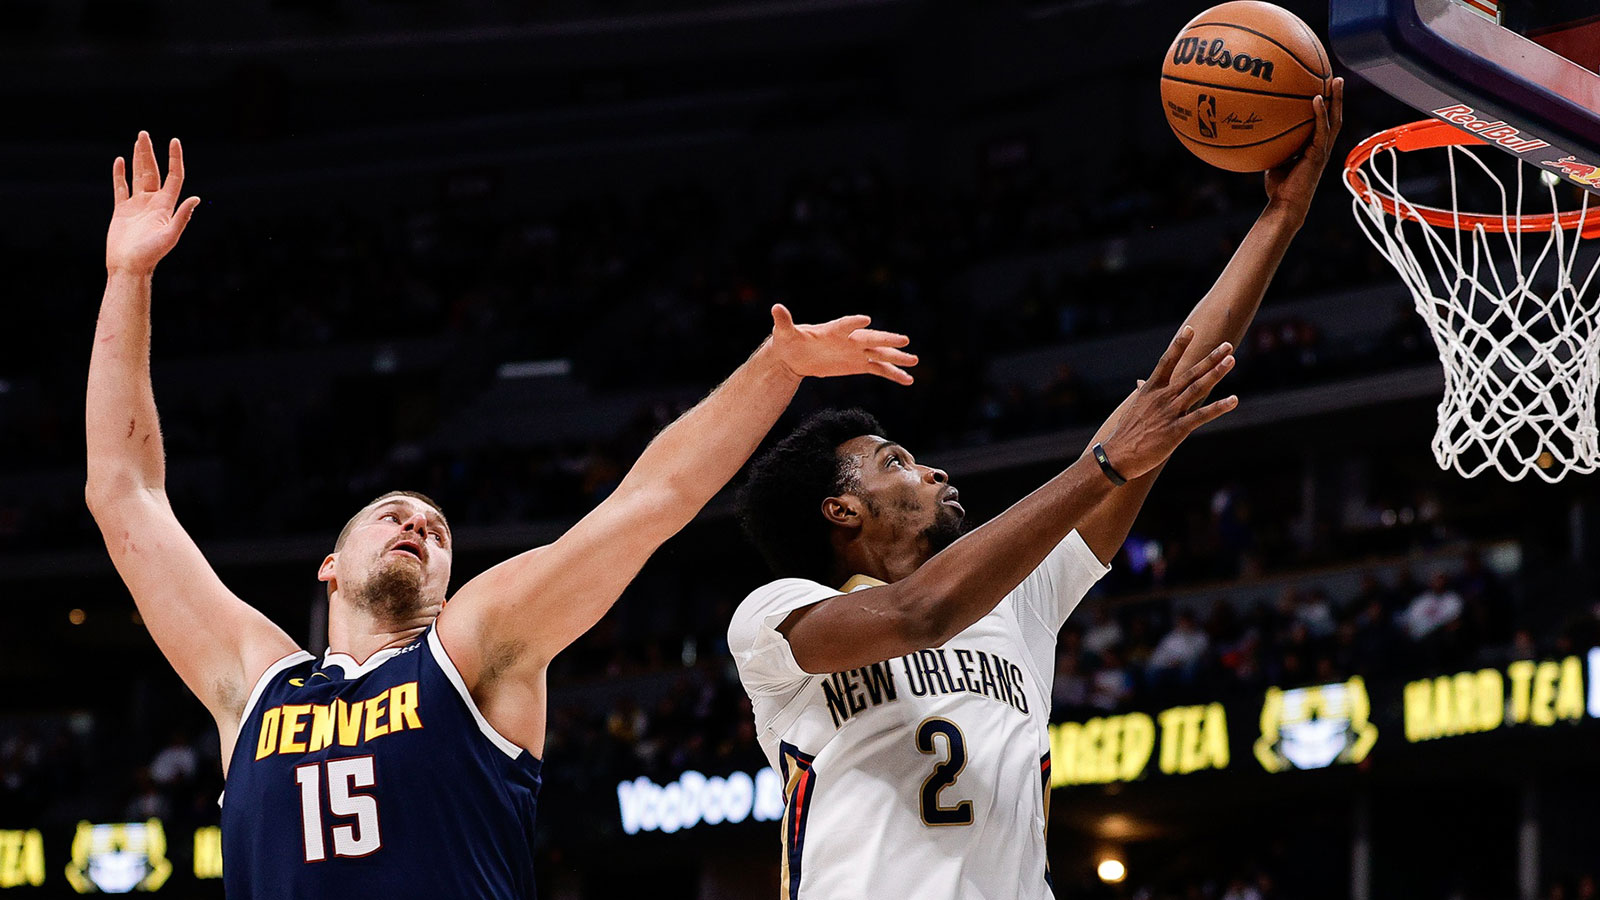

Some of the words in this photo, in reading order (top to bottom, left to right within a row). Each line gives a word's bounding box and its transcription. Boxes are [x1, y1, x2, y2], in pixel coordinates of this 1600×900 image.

[1173, 37, 1275, 83] Wilson
[254, 681, 424, 762] DENVER
[821, 659, 898, 731] NEW
[902, 648, 1030, 716] ORLEANS
[1507, 655, 1585, 726] TEA
[915, 716, 975, 827] 2
[1157, 701, 1230, 775] TEA
[294, 754, 383, 864] 15
